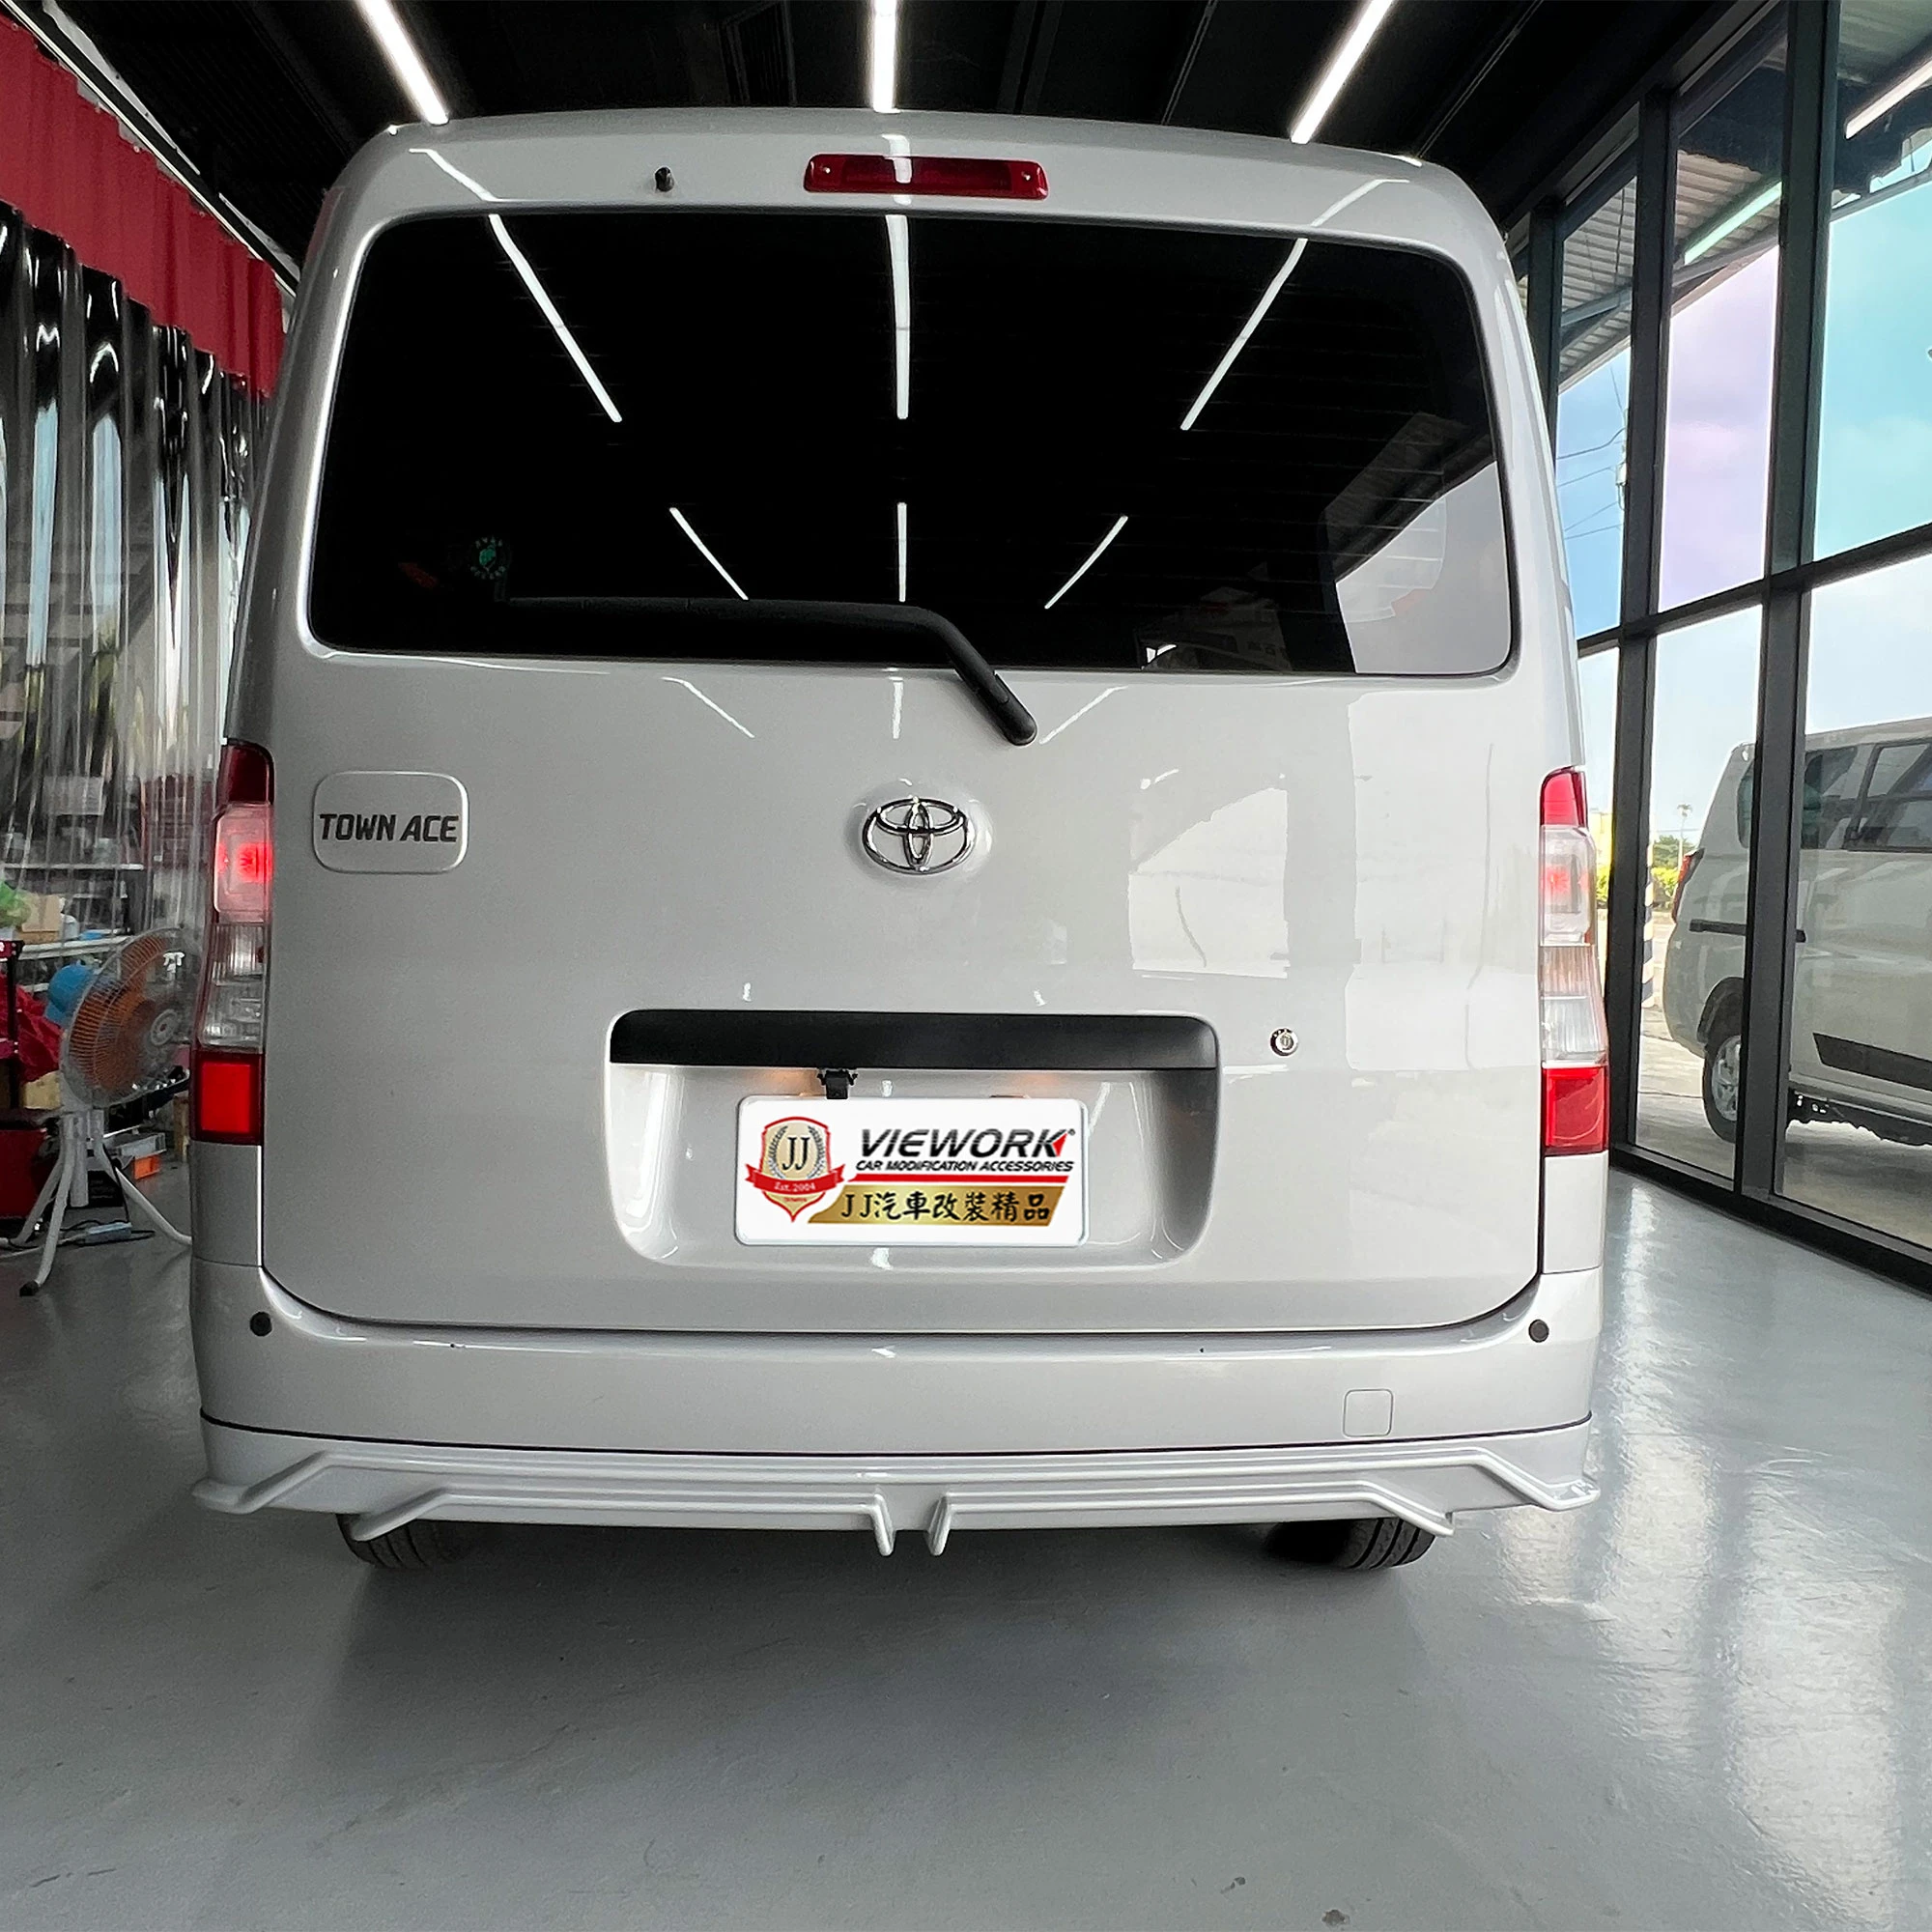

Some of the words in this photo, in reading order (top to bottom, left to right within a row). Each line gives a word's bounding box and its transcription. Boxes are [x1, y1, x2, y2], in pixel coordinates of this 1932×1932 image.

[319, 813, 397, 841] TOWN
[399, 814, 459, 842] ACE
[781, 1136, 810, 1171] JJ
[862, 1128, 1068, 1158] VIEWORK
[856, 1159, 883, 1172] CAR
[885, 1160, 979, 1172] MODIFICATION
[979, 1160, 1074, 1173] ACCESSORIES
